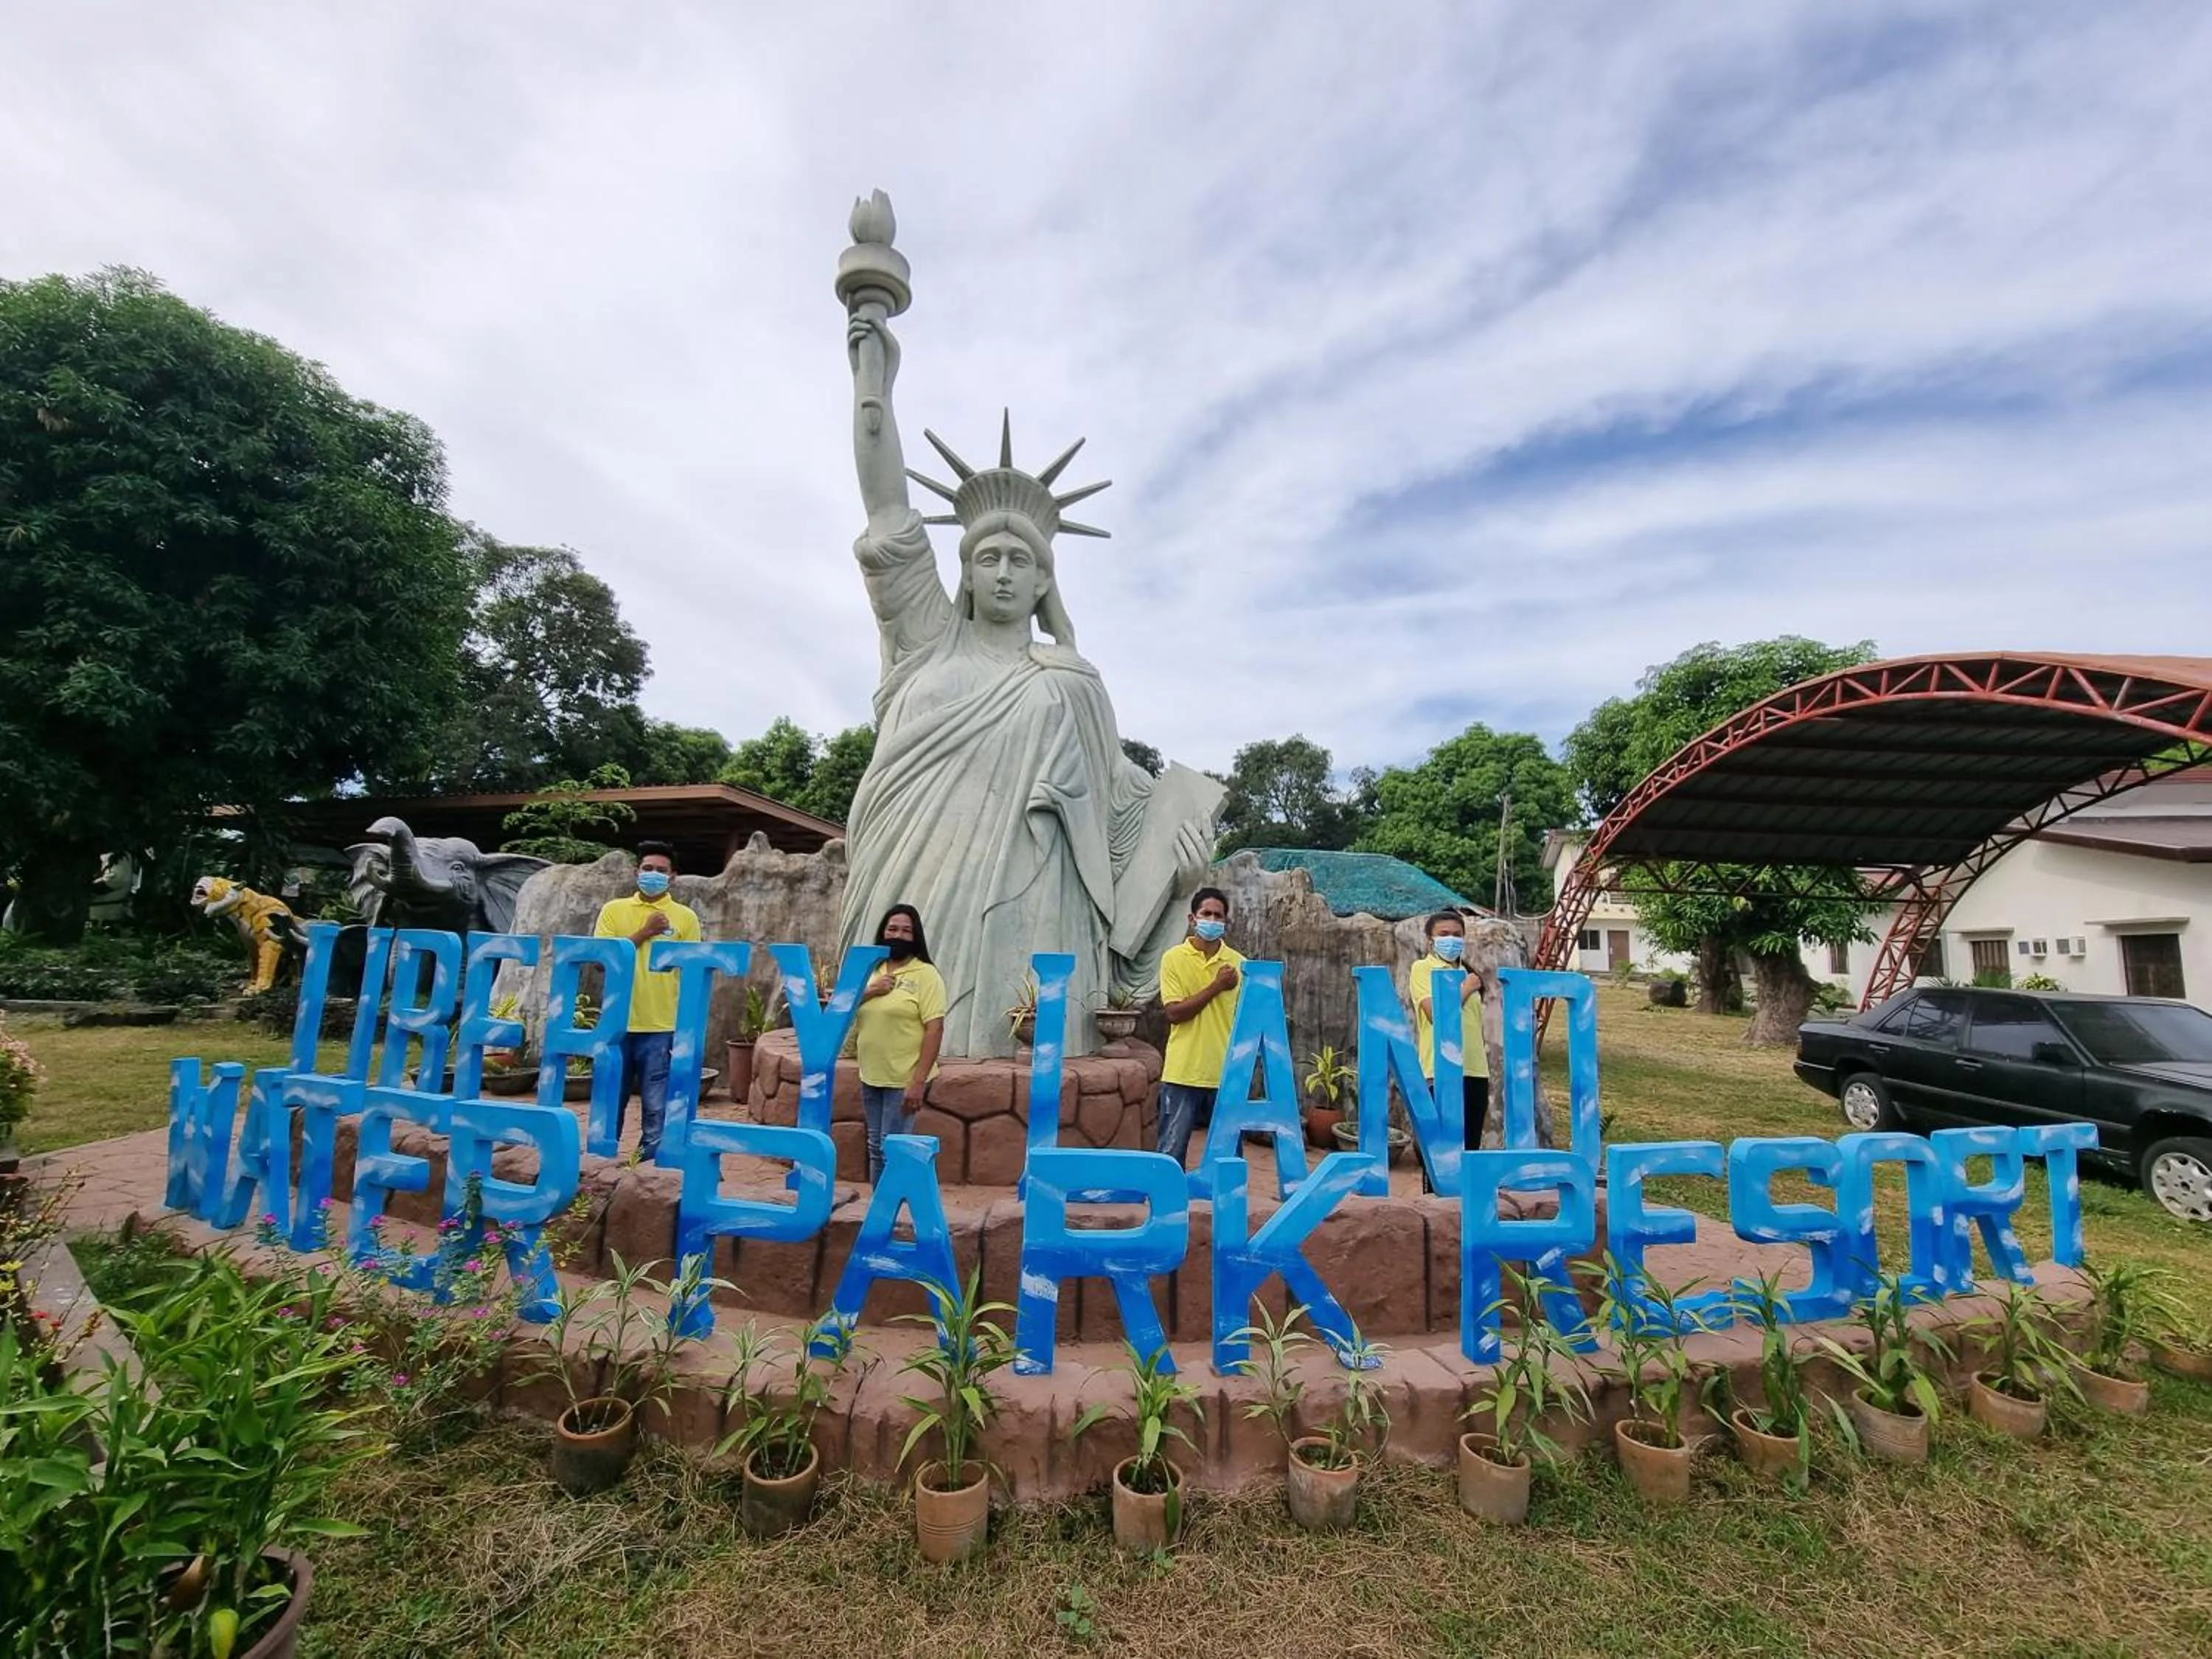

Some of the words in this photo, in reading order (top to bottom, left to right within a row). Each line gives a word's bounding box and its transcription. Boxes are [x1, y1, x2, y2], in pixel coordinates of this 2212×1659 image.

[164, 1057, 581, 1324] WATER
[668, 1119, 1385, 1377] PARK
[1461, 1122, 2099, 1365] RESORT
[1018, 953, 1599, 1202] LAND
